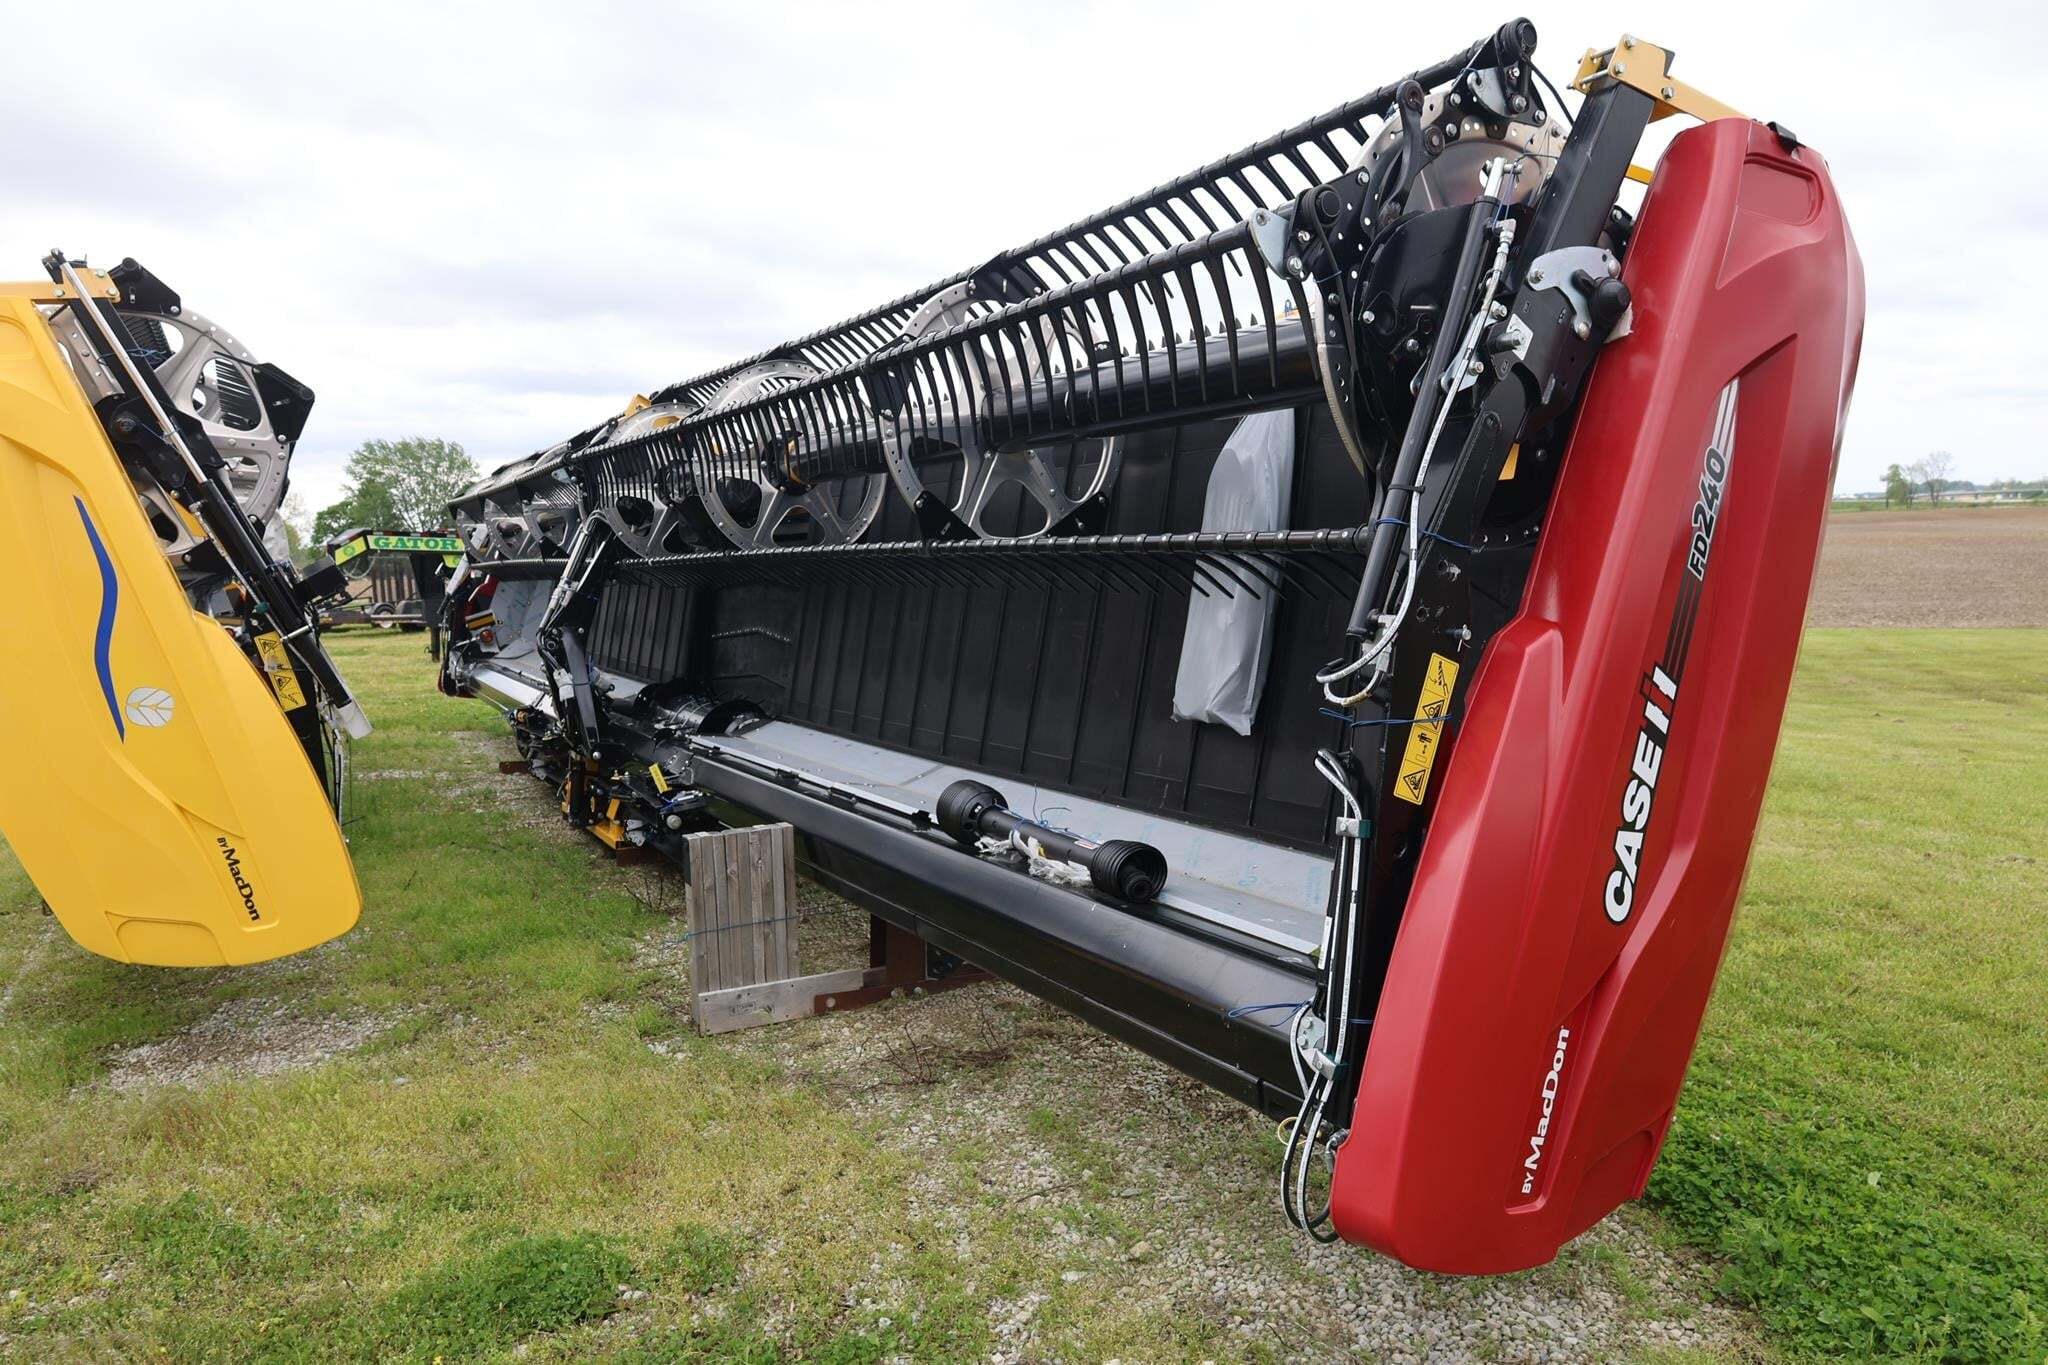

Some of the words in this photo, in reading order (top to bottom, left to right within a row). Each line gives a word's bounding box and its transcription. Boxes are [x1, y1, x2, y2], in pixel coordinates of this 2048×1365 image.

[374, 537, 457, 550] GATOR
[1687, 446, 1728, 581] FD240
[217, 837, 228, 848] BY
[1604, 732, 1664, 924] CASE
[222, 848, 261, 921] MacDon
[1524, 1028, 1570, 1170] MacDon
[1521, 1172, 1535, 1194] BY
